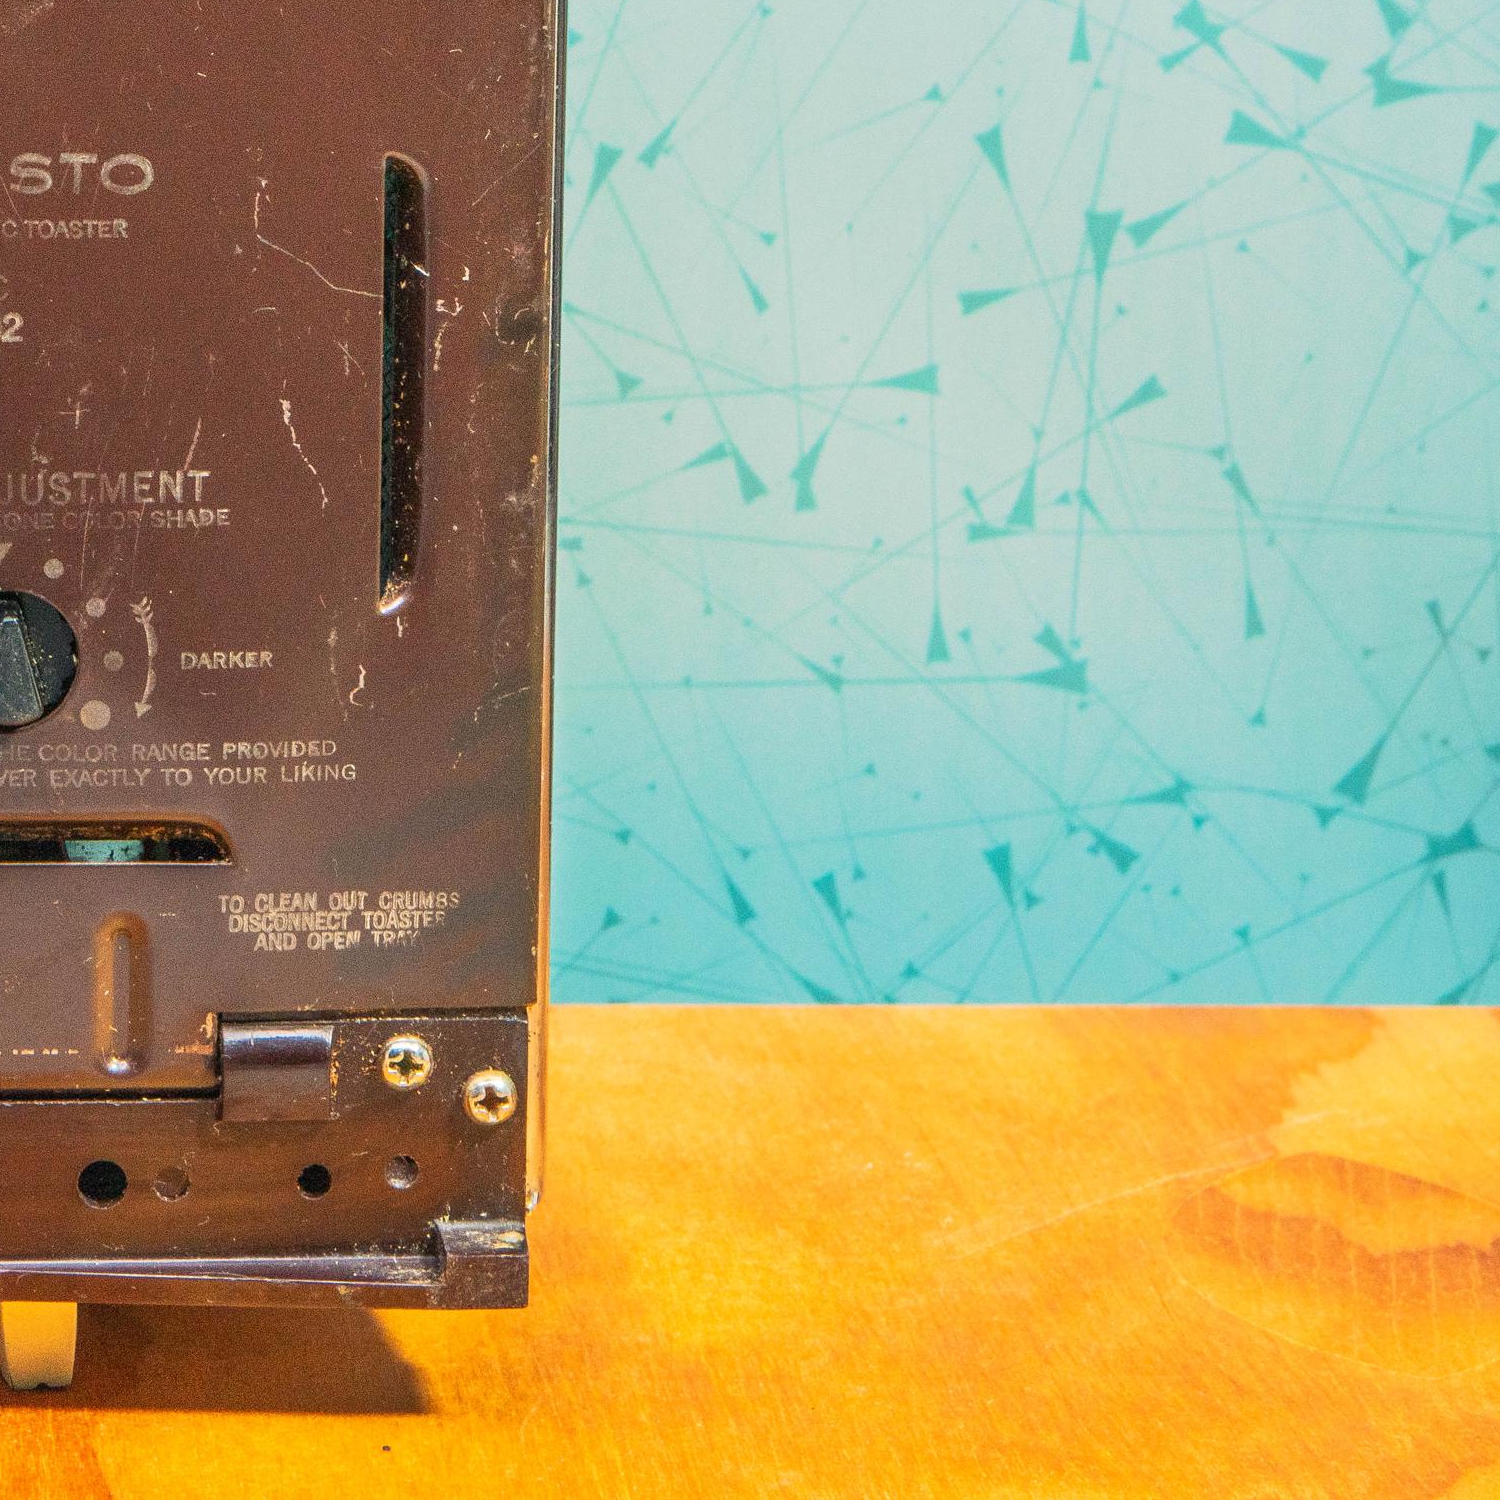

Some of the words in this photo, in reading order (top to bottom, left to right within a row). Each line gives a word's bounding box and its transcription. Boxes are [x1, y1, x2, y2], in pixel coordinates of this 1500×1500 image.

[23, 218, 129, 239] TOASTER
[2, 510, 55, 530] ONE
[62, 510, 143, 530] COLOR
[150, 507, 231, 529] SHADE
[180, 651, 274, 672] DARKER
[37, 743, 118, 763] COLOR
[131, 743, 211, 762] RANGE
[221, 740, 337, 760] PROVIDED
[49, 767, 152, 787] EXACTLY
[159, 767, 193, 786] TO
[203, 766, 268, 786] YOUR
[280, 762, 357, 783] LIKING
[217, 893, 245, 914] TO
[254, 891, 318, 913] CLEAN
[328, 891, 368, 911] OUT
[378, 890, 460, 910] CRUMBS
[228, 910, 351, 933] DISCONNECT
[361, 910, 446, 930] TOASTER
[253, 931, 297, 951] AND
[306, 930, 361, 950] OPEN
[370, 930, 420, 948] TRAY
